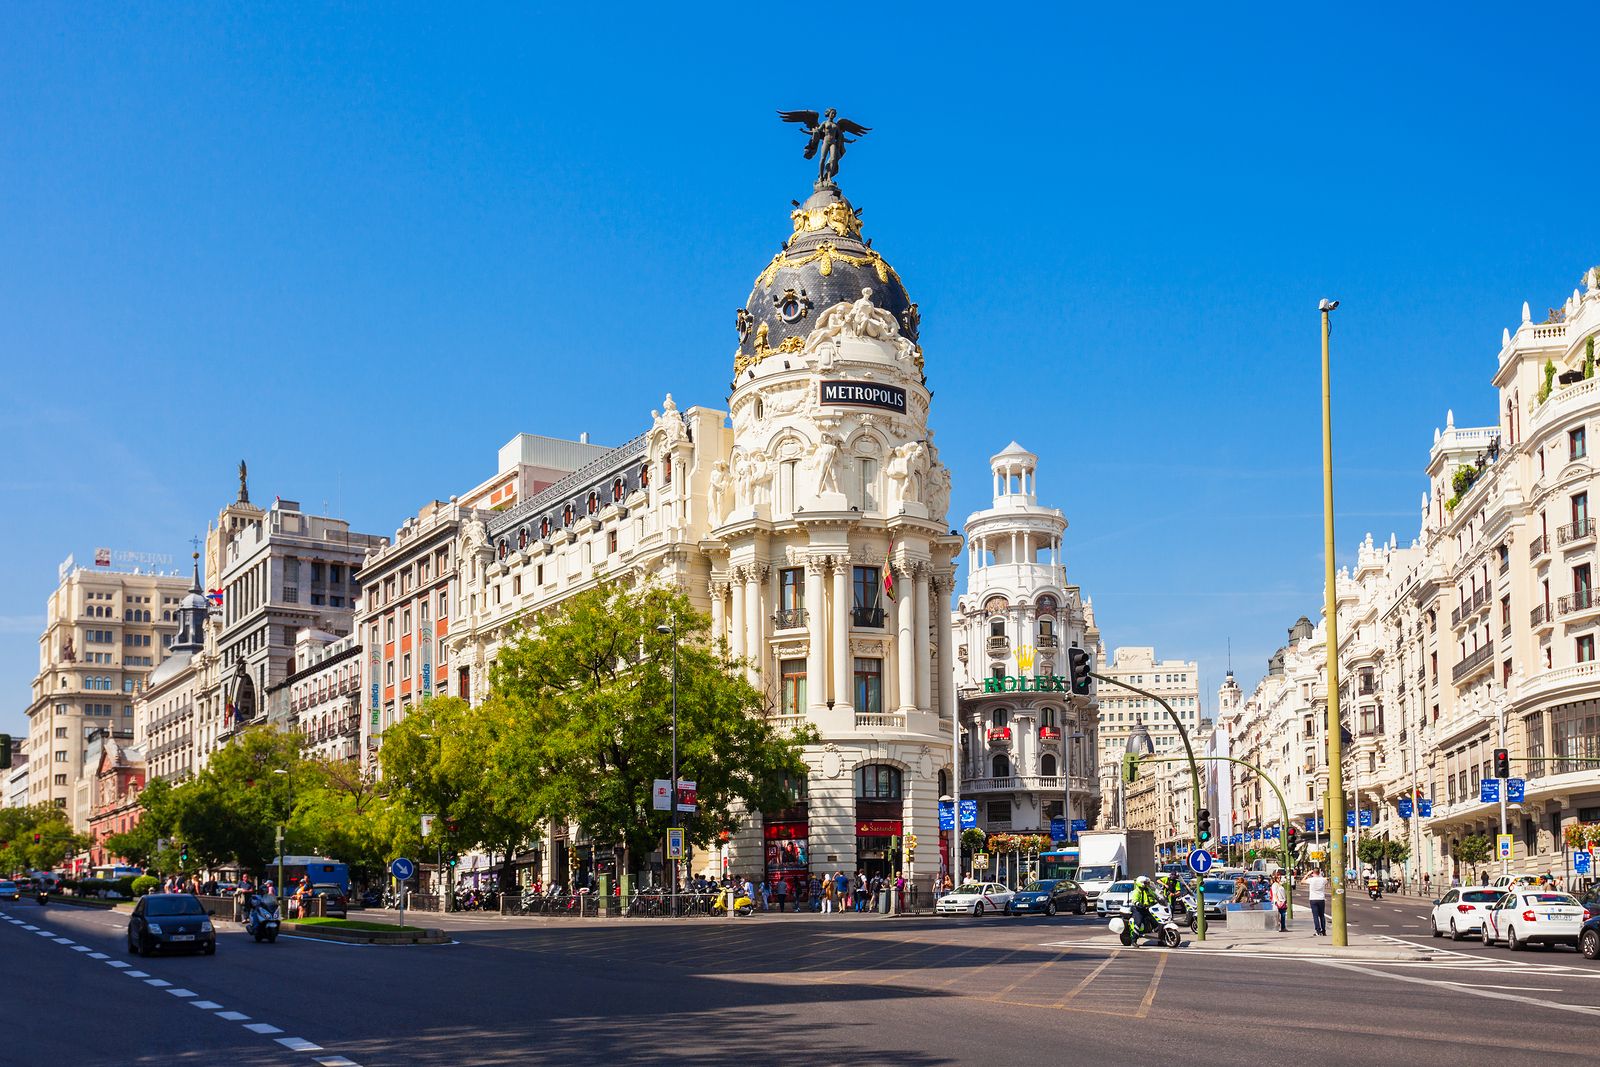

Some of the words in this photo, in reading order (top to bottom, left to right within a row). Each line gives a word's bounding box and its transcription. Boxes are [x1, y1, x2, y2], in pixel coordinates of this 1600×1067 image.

[825, 385, 904, 407] METROPOLIS
[422, 663, 430, 689] salida
[983, 675, 1066, 693] ROLEX
[371, 683, 379, 708] salida
[371, 709, 380, 725] hay
[1575, 853, 1585, 865] P
